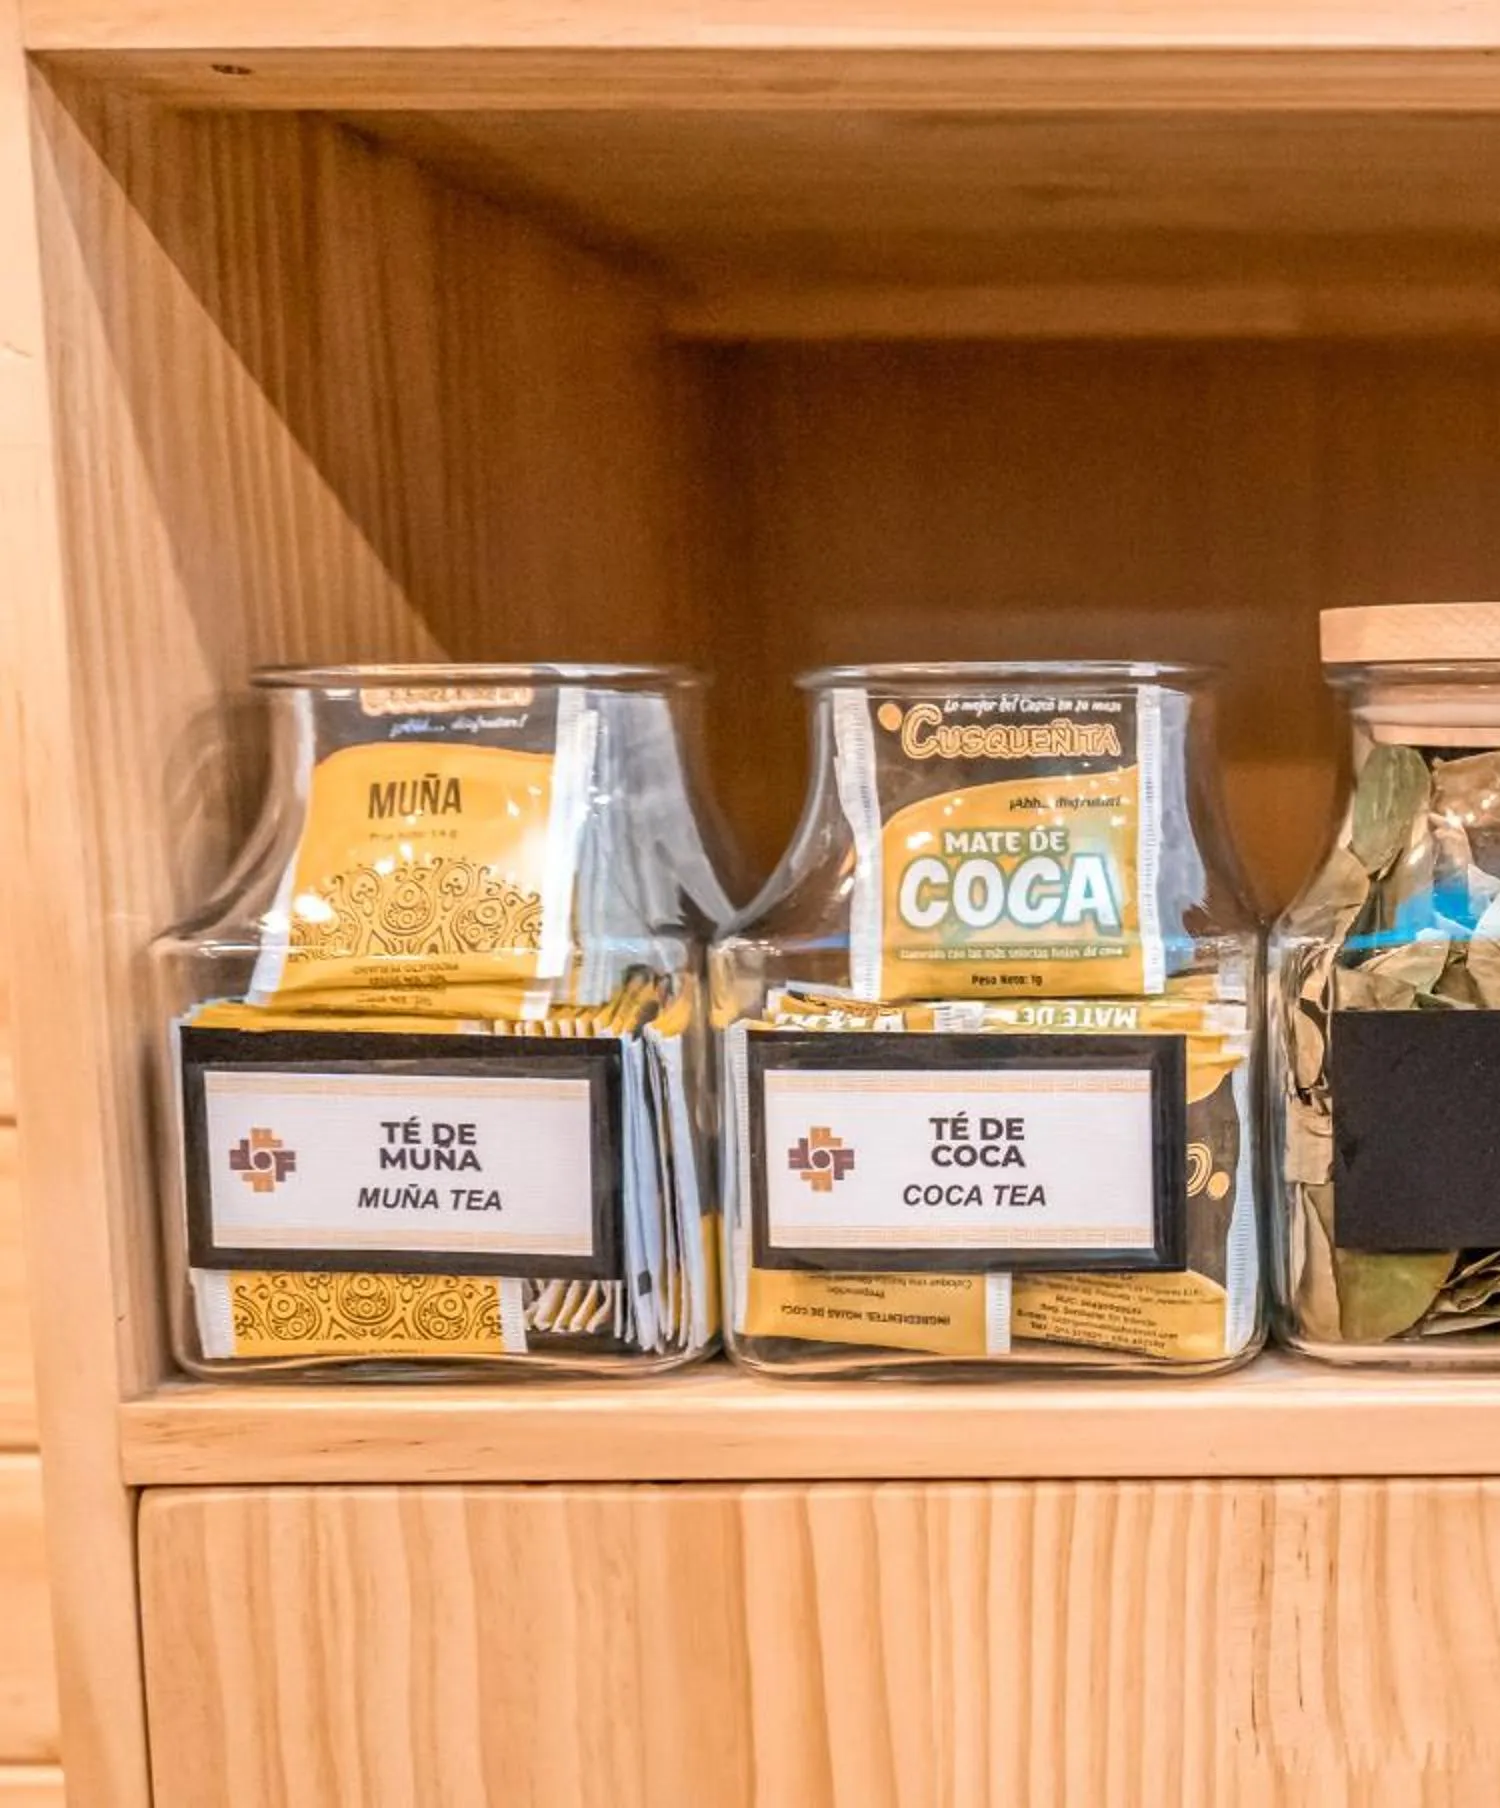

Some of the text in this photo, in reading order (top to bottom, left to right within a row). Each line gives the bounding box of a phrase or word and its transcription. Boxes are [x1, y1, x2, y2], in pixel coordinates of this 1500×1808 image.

[368, 773, 462, 819] MUÑA
[944, 830, 1066, 853] MATE DE
[899, 855, 1122, 934] COCA
[972, 975, 997, 985] Peso
[1064, 1007, 1138, 1028] MATE
[380, 1115, 477, 1145] TÉ DE
[928, 1111, 1025, 1140] TÉ DE
[379, 1141, 482, 1171] MUÑA
[931, 1144, 1026, 1167] COCA
[357, 1183, 502, 1211] MUÑA TEA
[903, 1184, 1046, 1207] COCA TEA
[811, 1307, 825, 1318] DE
